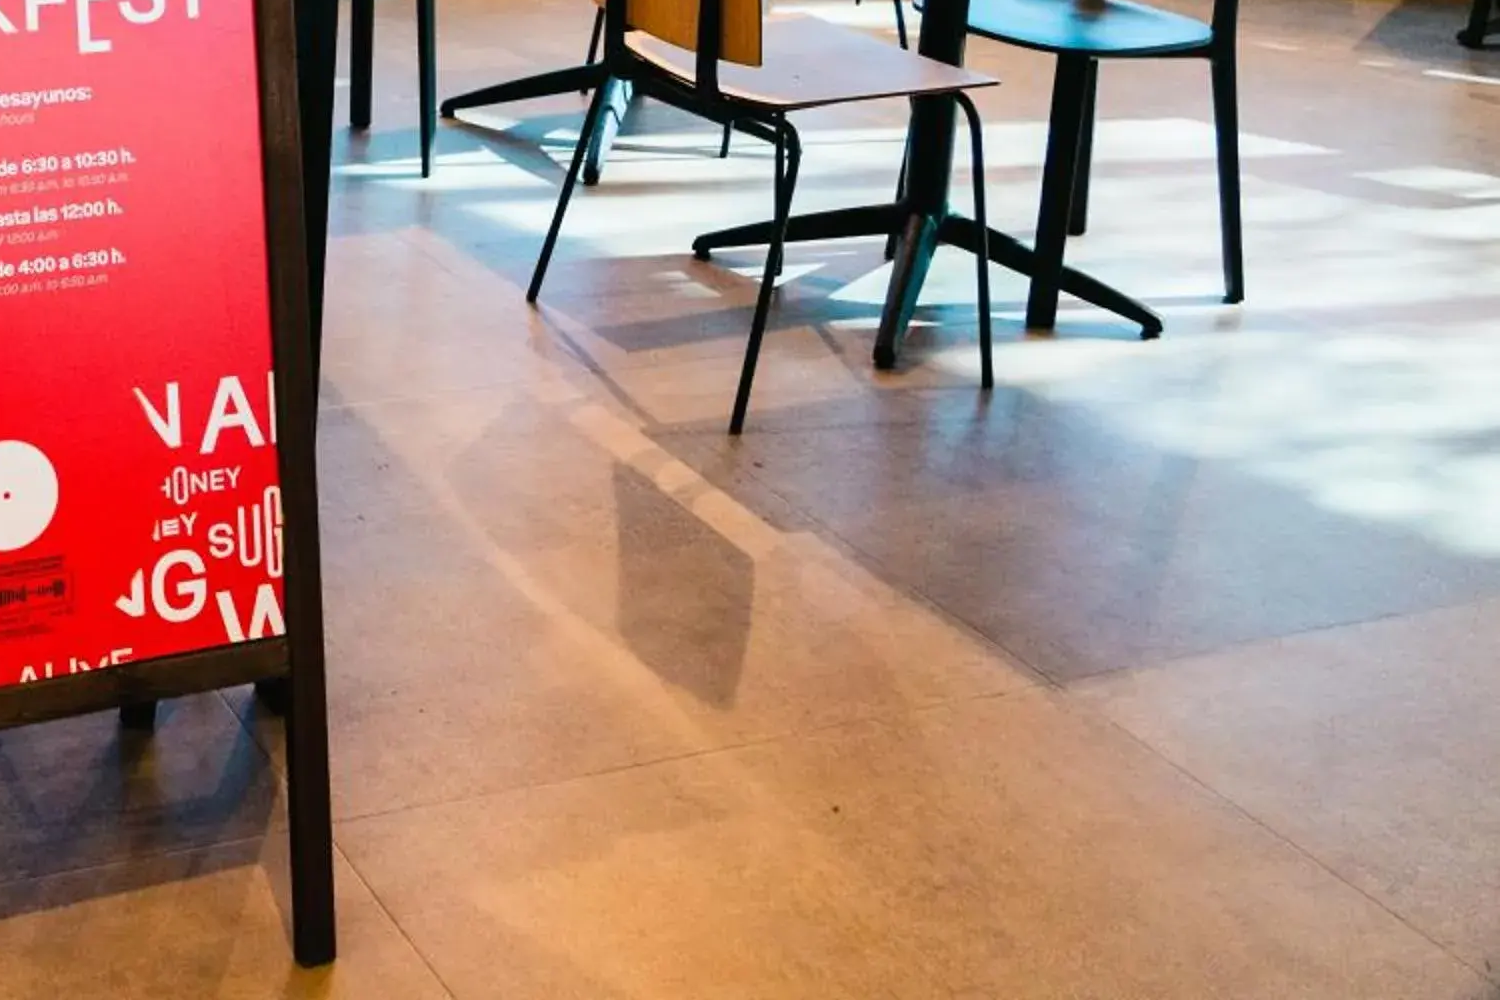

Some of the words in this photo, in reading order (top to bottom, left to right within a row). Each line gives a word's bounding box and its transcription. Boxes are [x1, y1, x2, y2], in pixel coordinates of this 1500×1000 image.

[21, 156, 58, 174] 6:30
[61, 157, 71, 171] a
[75, 150, 117, 168] 10:30
[120, 147, 136, 164] h.
[33, 205, 58, 223] las
[60, 201, 104, 220] 12:00
[107, 198, 123, 215] h.
[18, 256, 56, 274] 4:00
[59, 256, 69, 270] a
[72, 250, 108, 268] 6:30
[111, 247, 126, 264] h.
